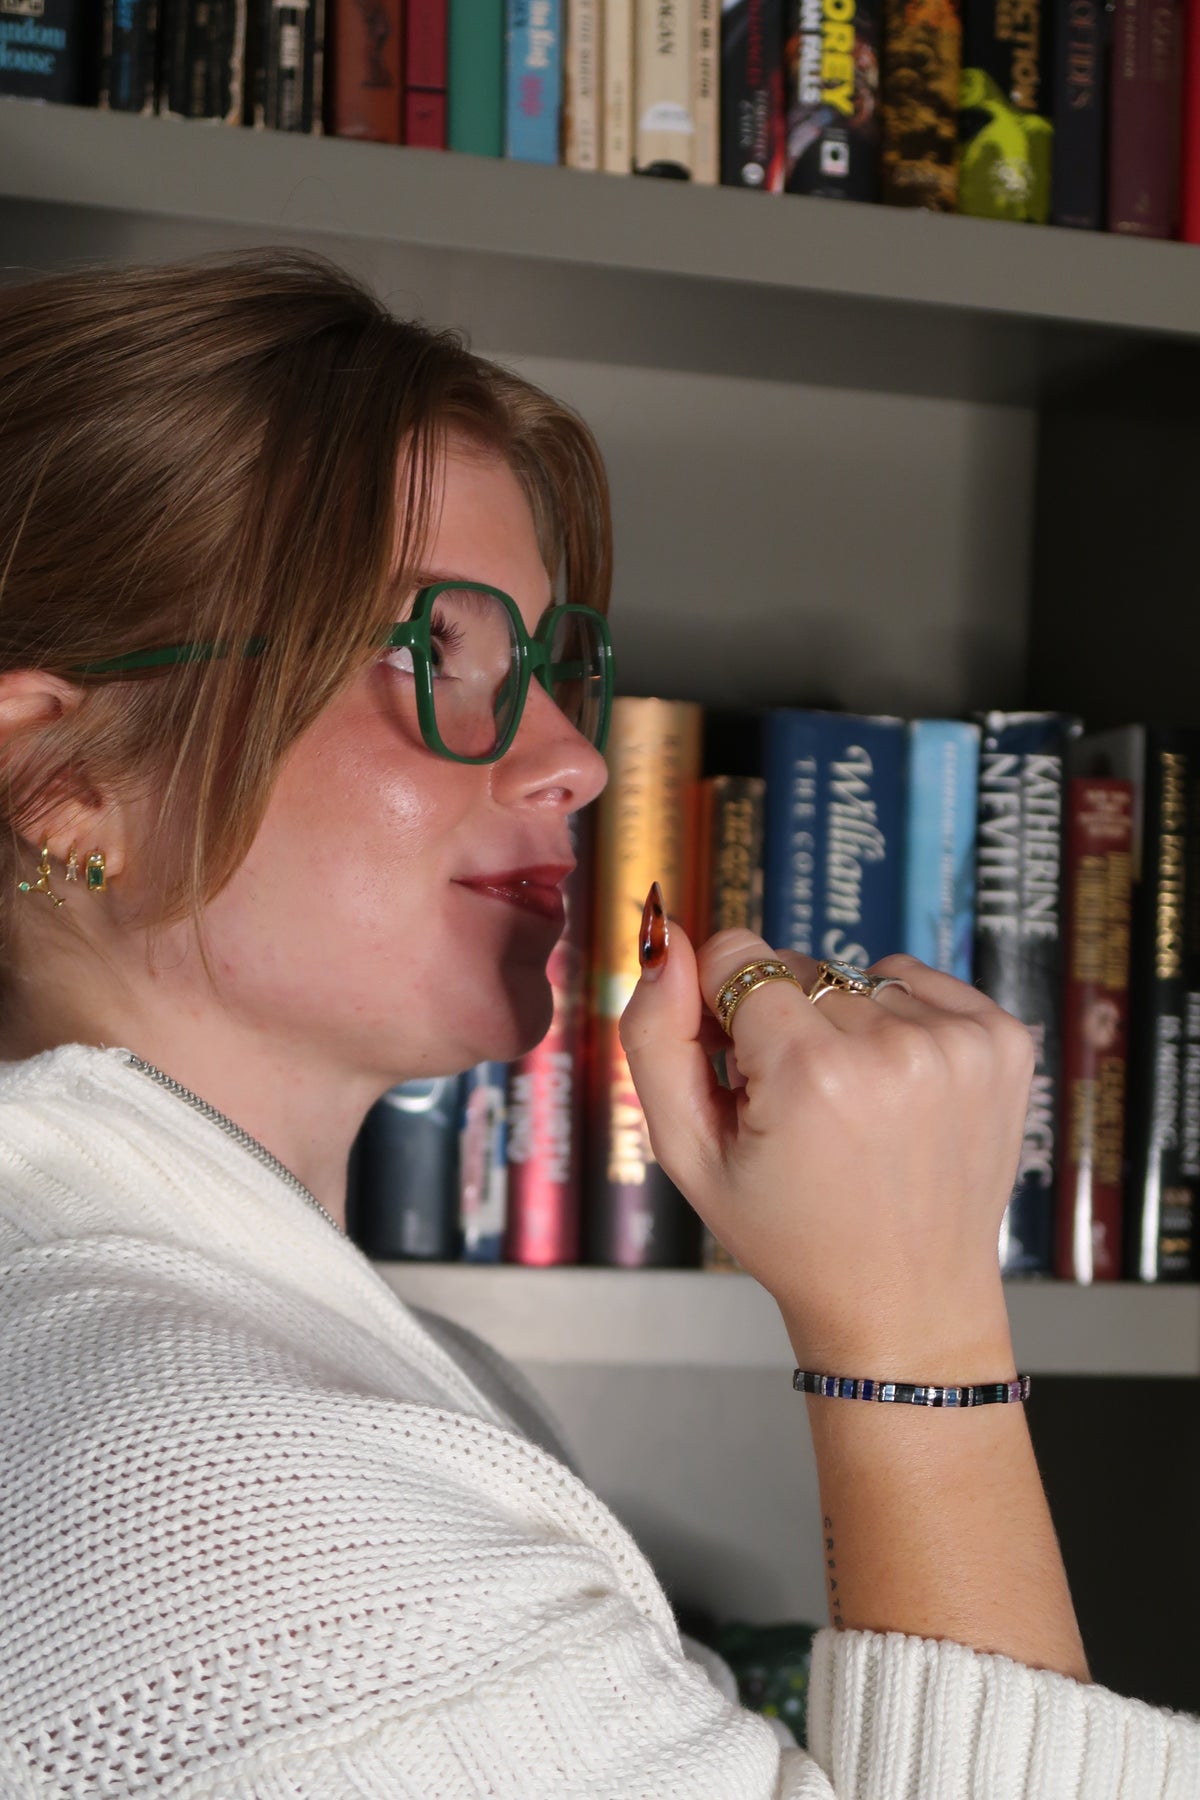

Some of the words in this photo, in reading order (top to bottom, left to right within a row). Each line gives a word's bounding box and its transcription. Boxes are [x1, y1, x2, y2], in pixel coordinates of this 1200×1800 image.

[797, 34, 822, 104] FALLS
[793, 756, 818, 819] THE
[825, 745, 887, 925] William
[977, 754, 1018, 936] NEVILLE
[1022, 754, 1061, 939] KATHERINE
[790, 830, 816, 955] COMPLE
[822, 928, 871, 971] S
[539, 1051, 573, 1184] FOURTH
[1017, 1073, 1054, 1188] MAGIC
